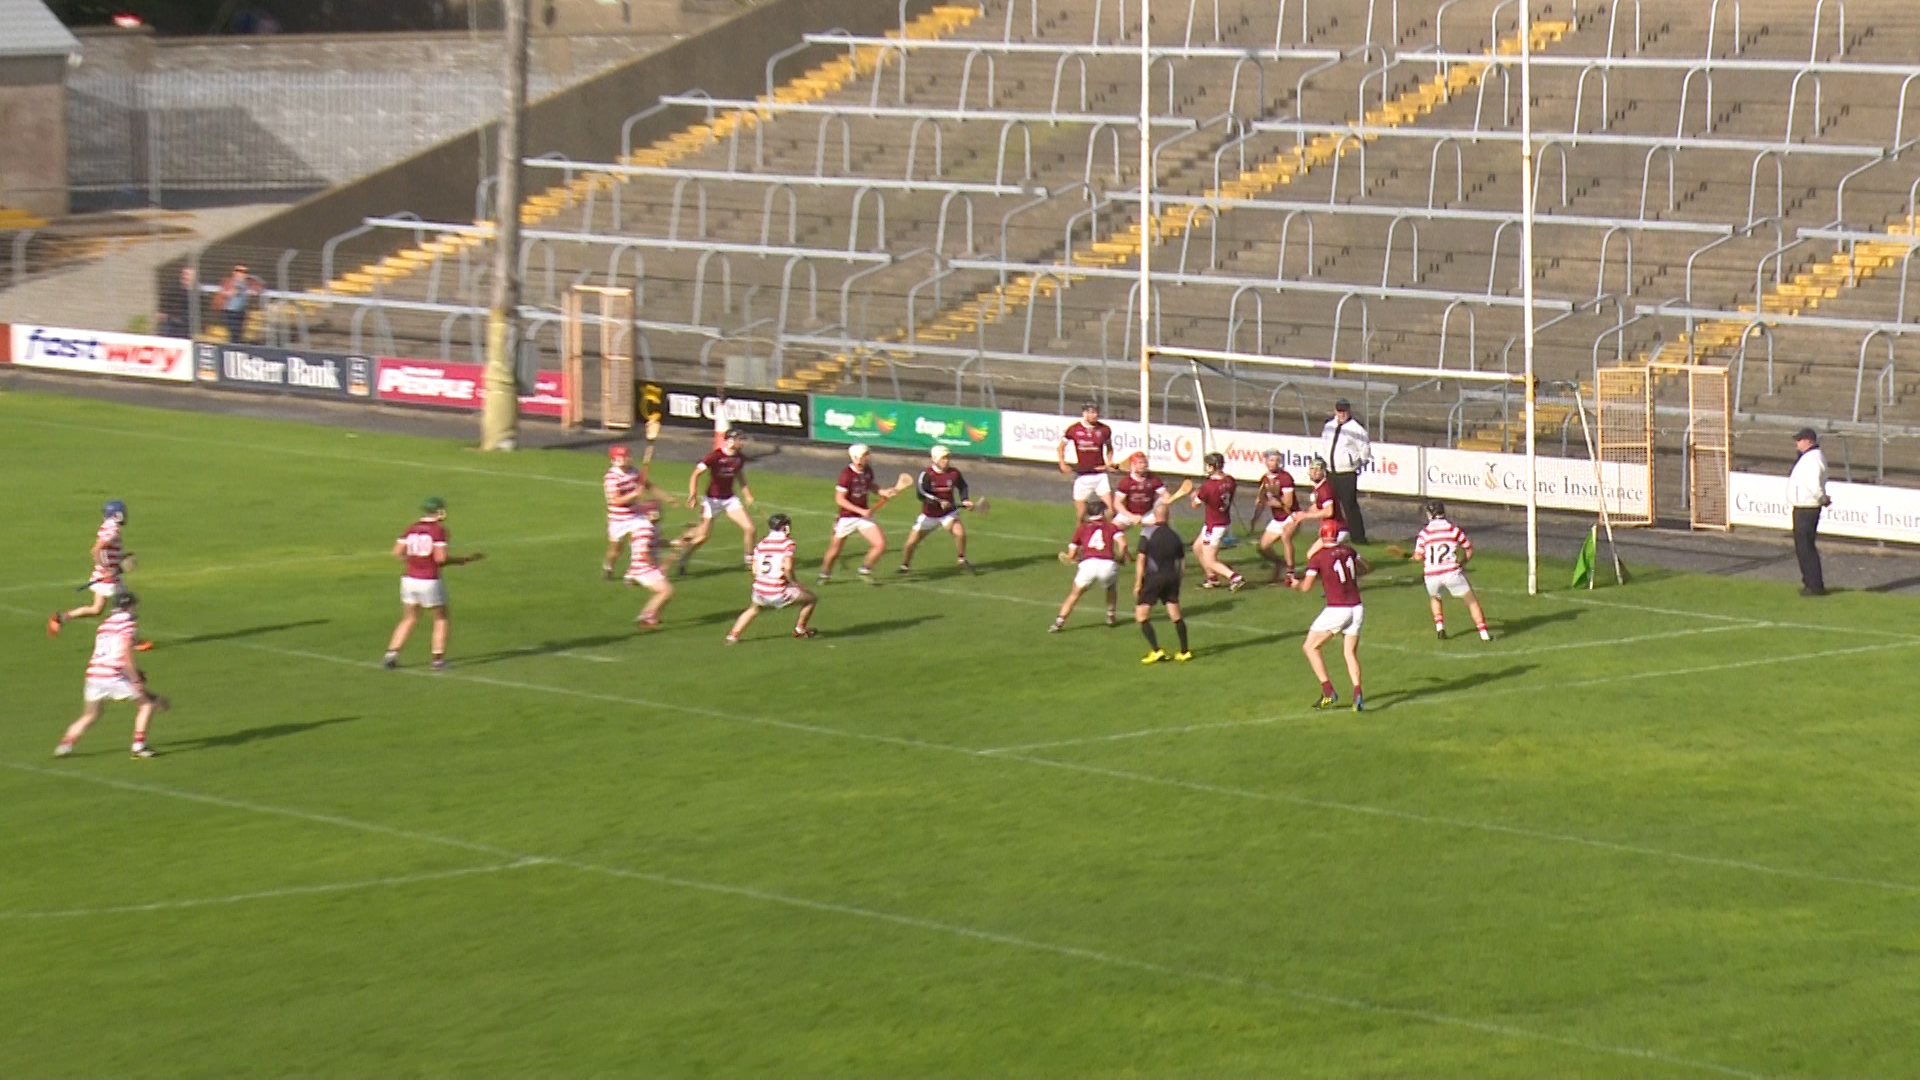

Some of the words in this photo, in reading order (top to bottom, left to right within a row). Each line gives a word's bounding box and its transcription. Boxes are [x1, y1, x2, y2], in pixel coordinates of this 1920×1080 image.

[25, 328, 183, 373] fastway
[223, 350, 286, 384] Ulster
[287, 356, 341, 389] Bank
[377, 368, 476, 400] PEOPLE
[666, 393, 700, 418] THE
[702, 396, 763, 424] COWN
[764, 401, 803, 428] BAR
[1013, 422, 1067, 443] glanbi
[1427, 465, 1480, 487] Creane
[1503, 471, 1557, 494] Crene
[1736, 492, 1790, 516] Creane
[1820, 502, 1869, 524] reane
[406, 532, 433, 556] 10
[1088, 529, 1106, 550] 4
[1429, 543, 1452, 564] 12
[761, 555, 773, 574] 5
[1333, 555, 1356, 584] 11
